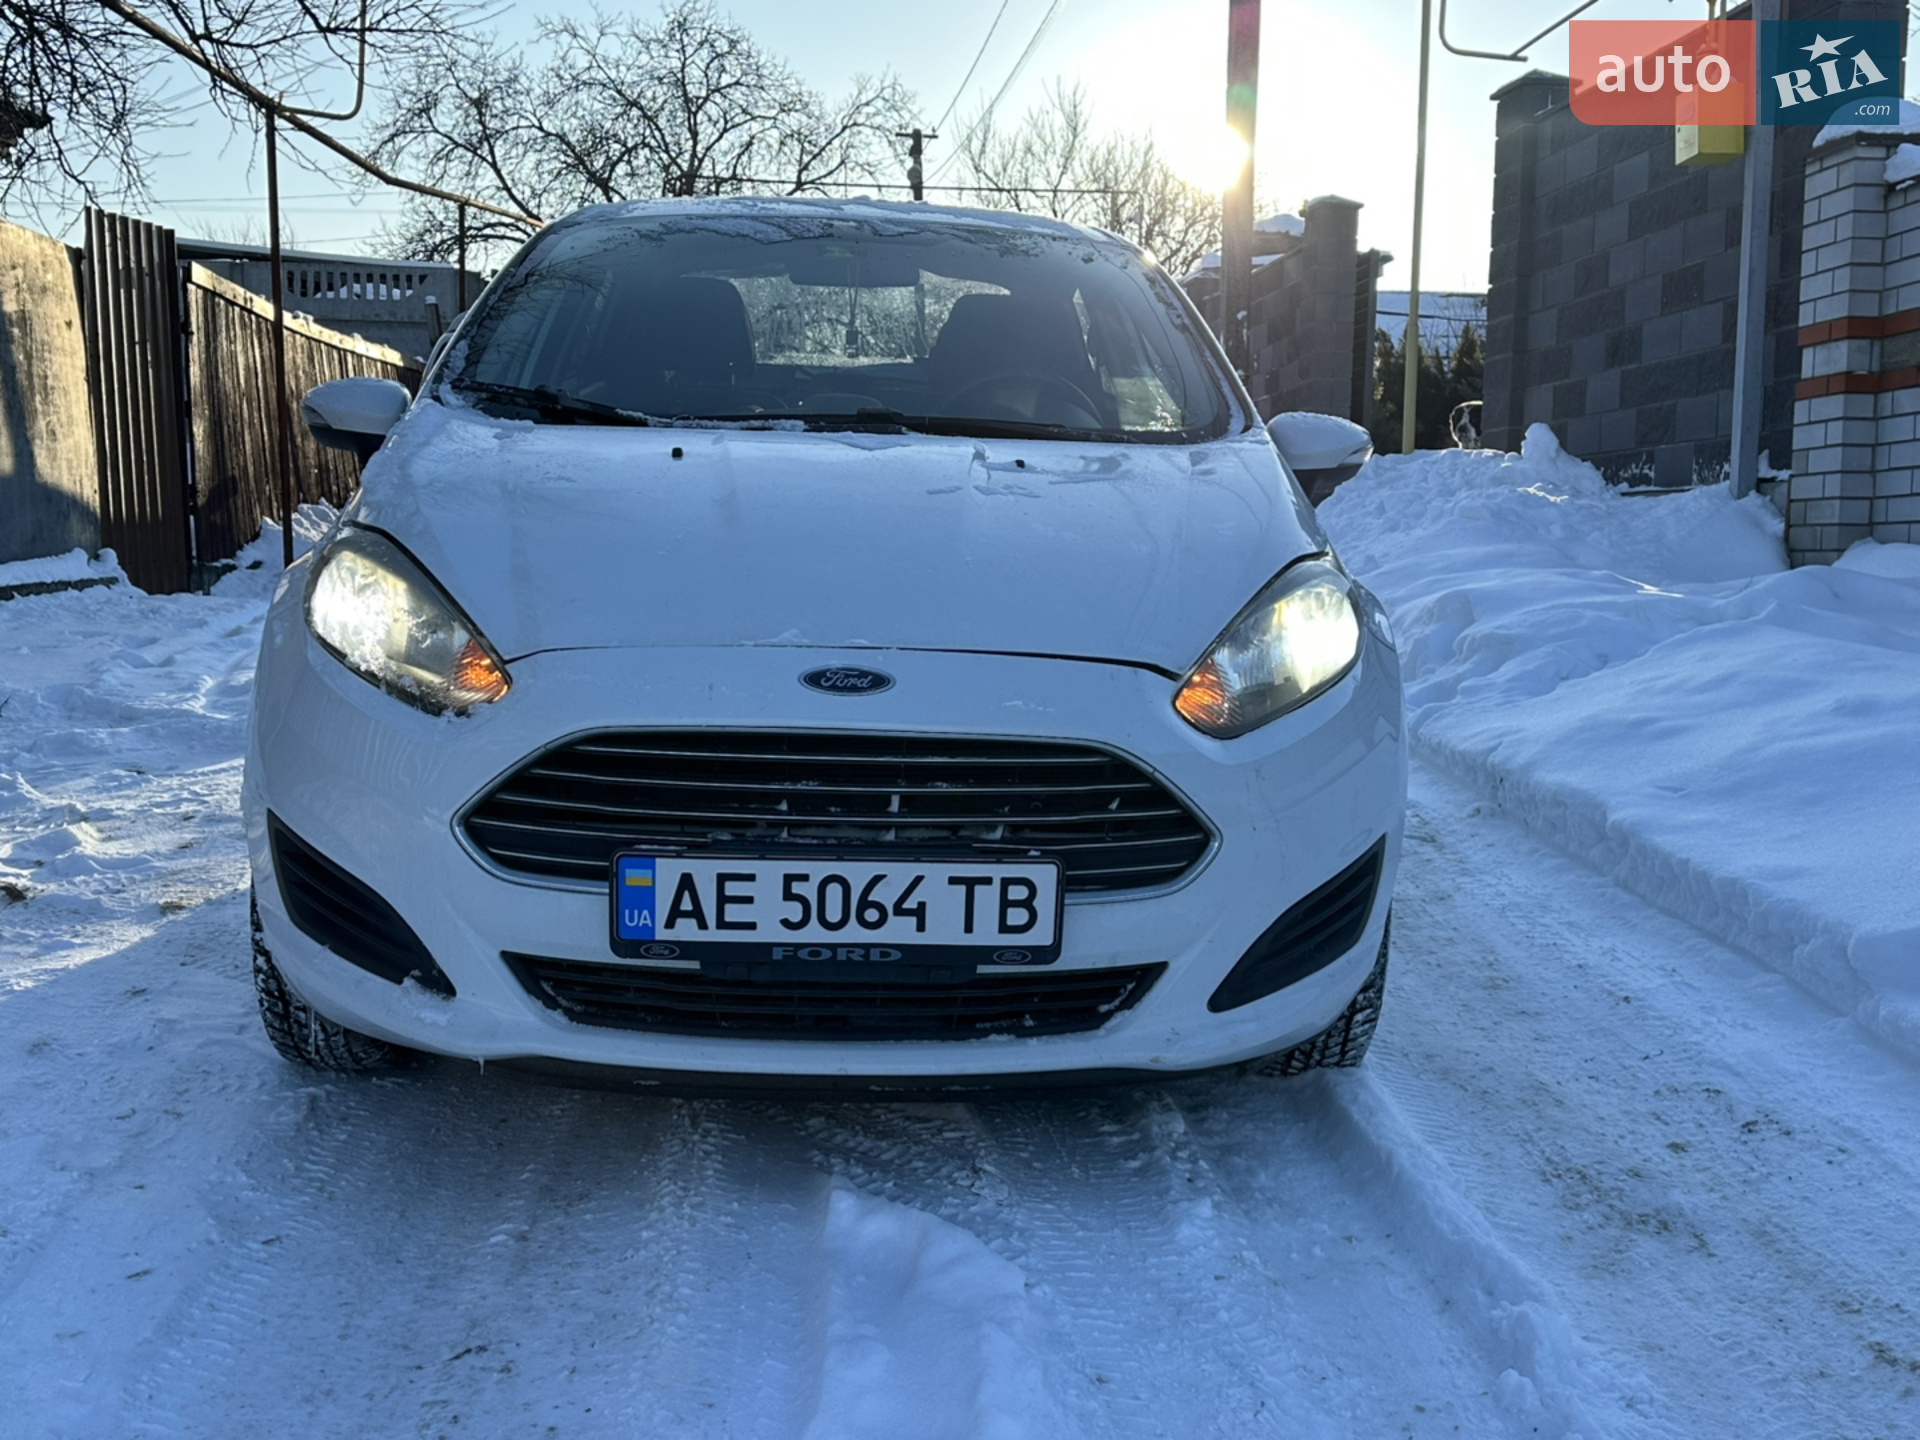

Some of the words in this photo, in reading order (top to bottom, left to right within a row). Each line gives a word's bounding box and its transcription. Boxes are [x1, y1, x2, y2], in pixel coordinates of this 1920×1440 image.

[820, 669, 873, 688] Ford
[663, 871, 758, 931] AE
[778, 872, 927, 933] 5064
[947, 875, 1039, 935] TB
[624, 909, 653, 928] UA
[772, 946, 903, 962] FORD
